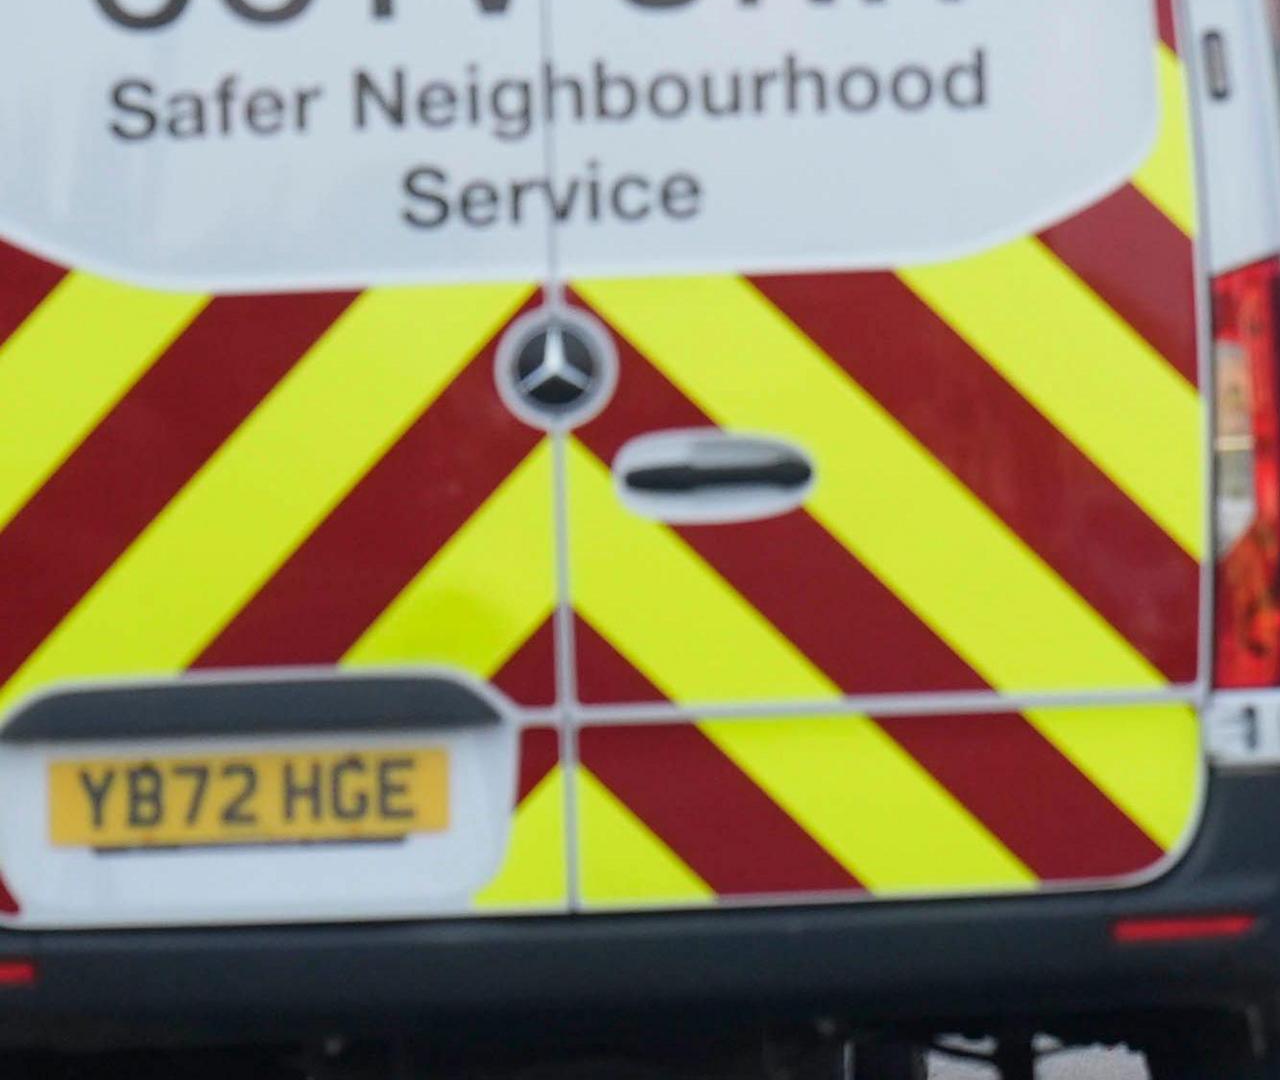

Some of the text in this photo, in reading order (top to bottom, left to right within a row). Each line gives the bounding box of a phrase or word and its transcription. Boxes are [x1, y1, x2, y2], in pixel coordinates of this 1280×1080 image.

[108, 48, 989, 144] Safer Neighbourhood
[402, 161, 703, 232] Service
[78, 756, 416, 827] YB72 HGE
